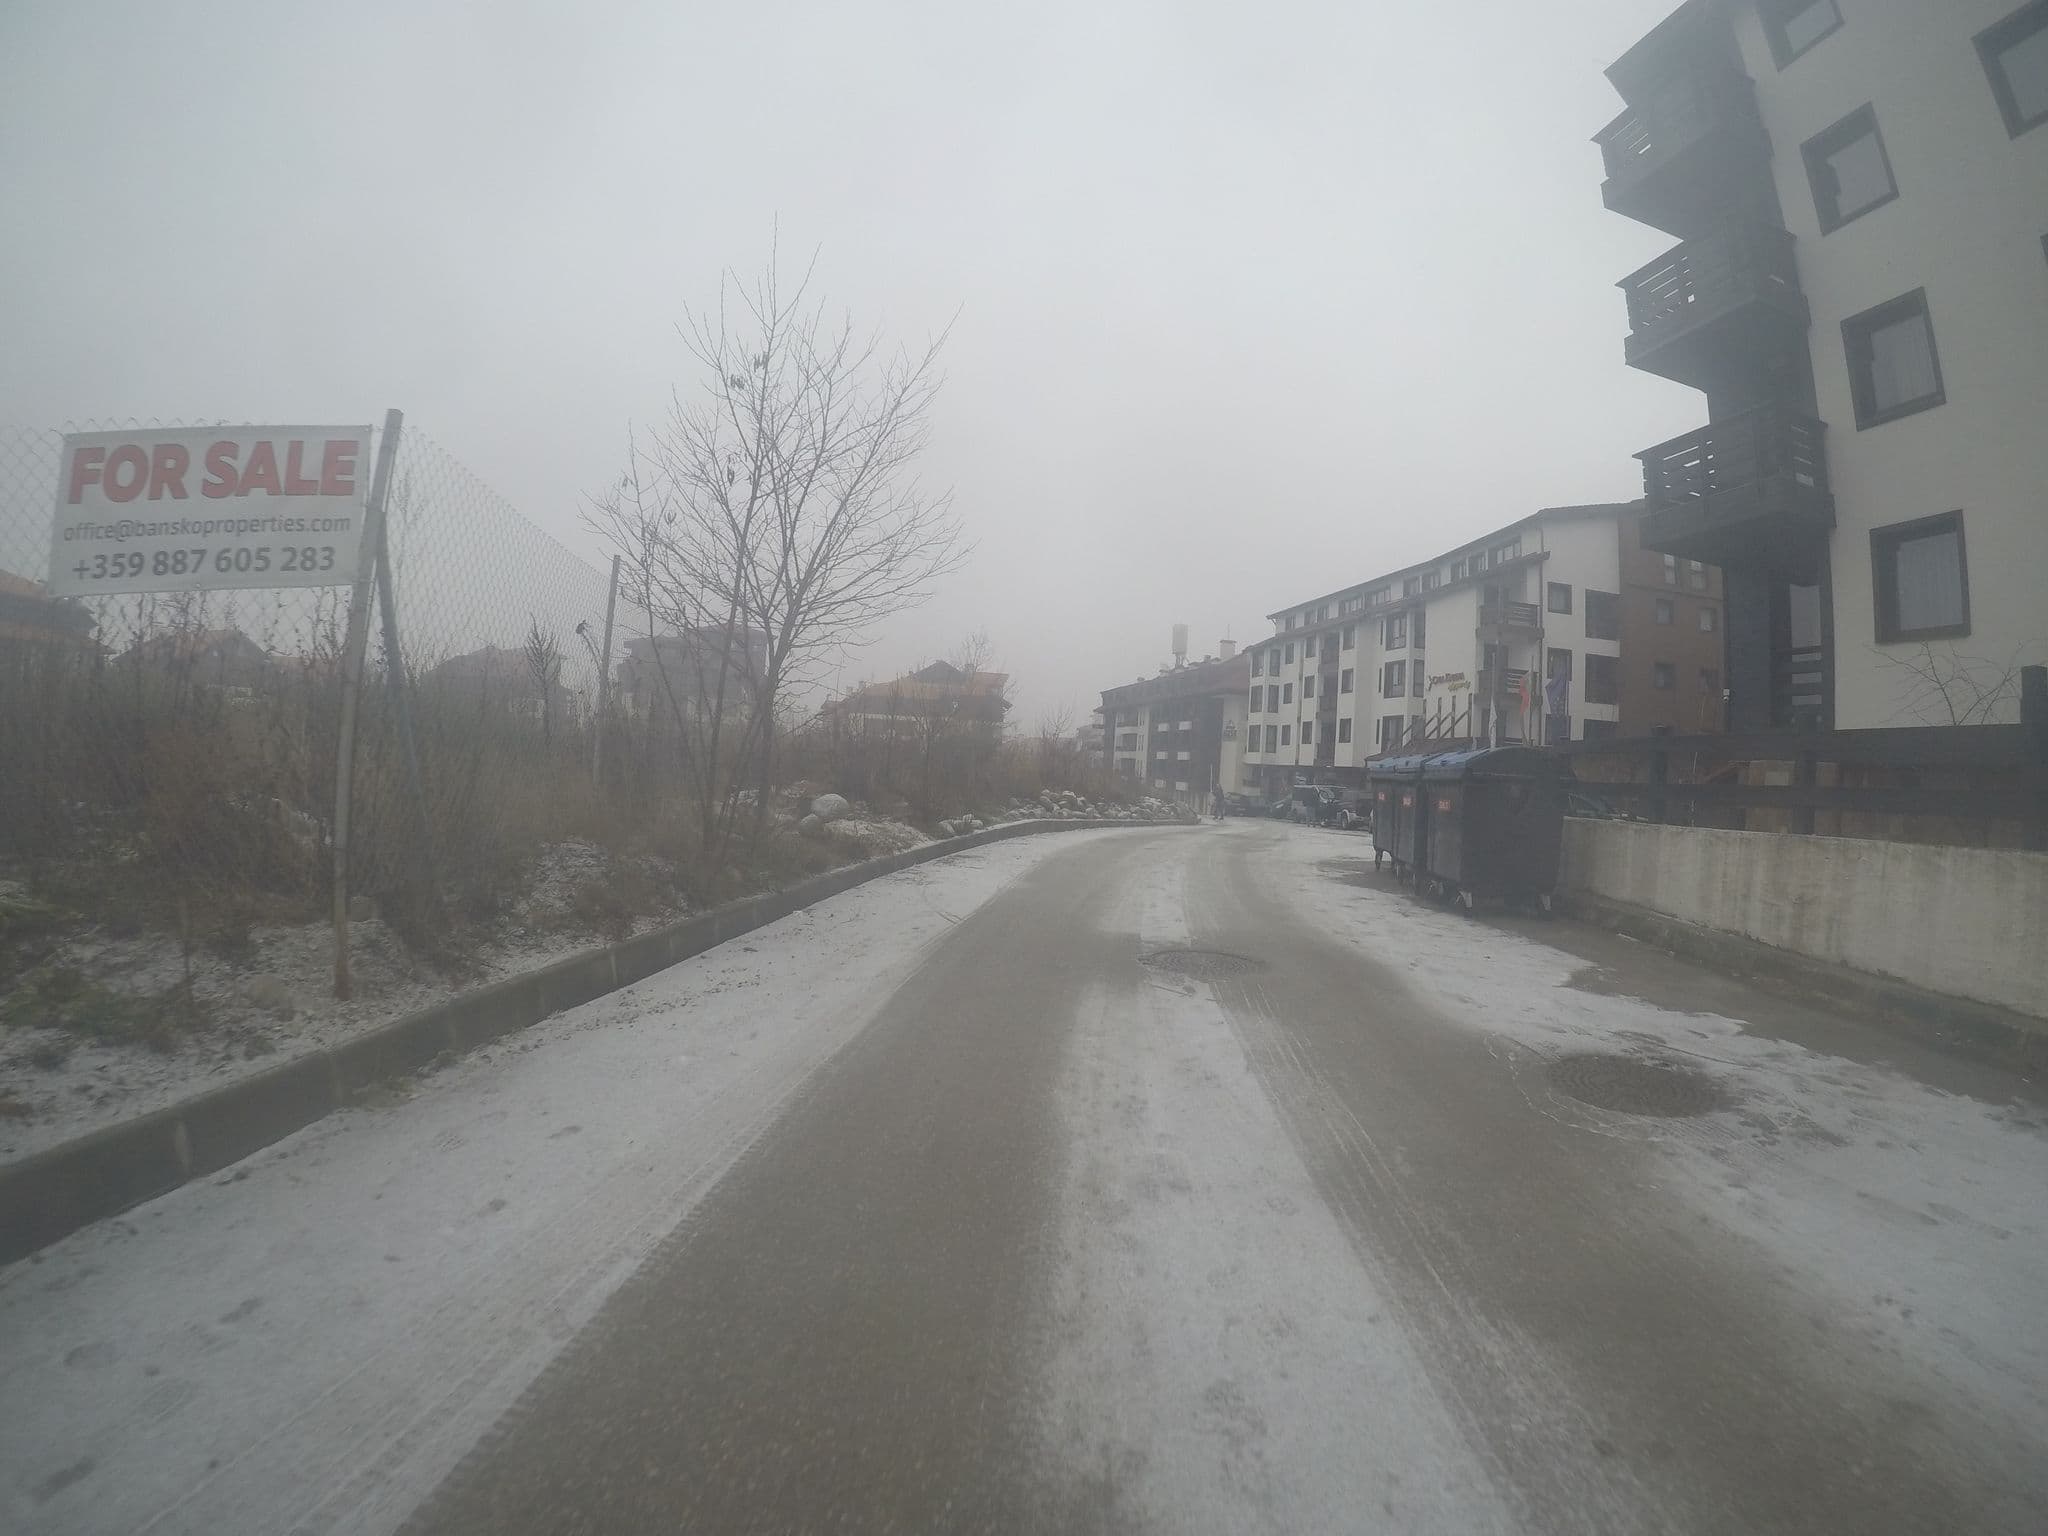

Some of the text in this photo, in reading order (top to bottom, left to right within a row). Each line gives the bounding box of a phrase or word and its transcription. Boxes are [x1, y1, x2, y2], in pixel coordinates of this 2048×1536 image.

[67, 440, 360, 505] FOR SALE
[63, 514, 351, 543] office@banskoproperties.com
[72, 545, 336, 580] +359 887 605 283
